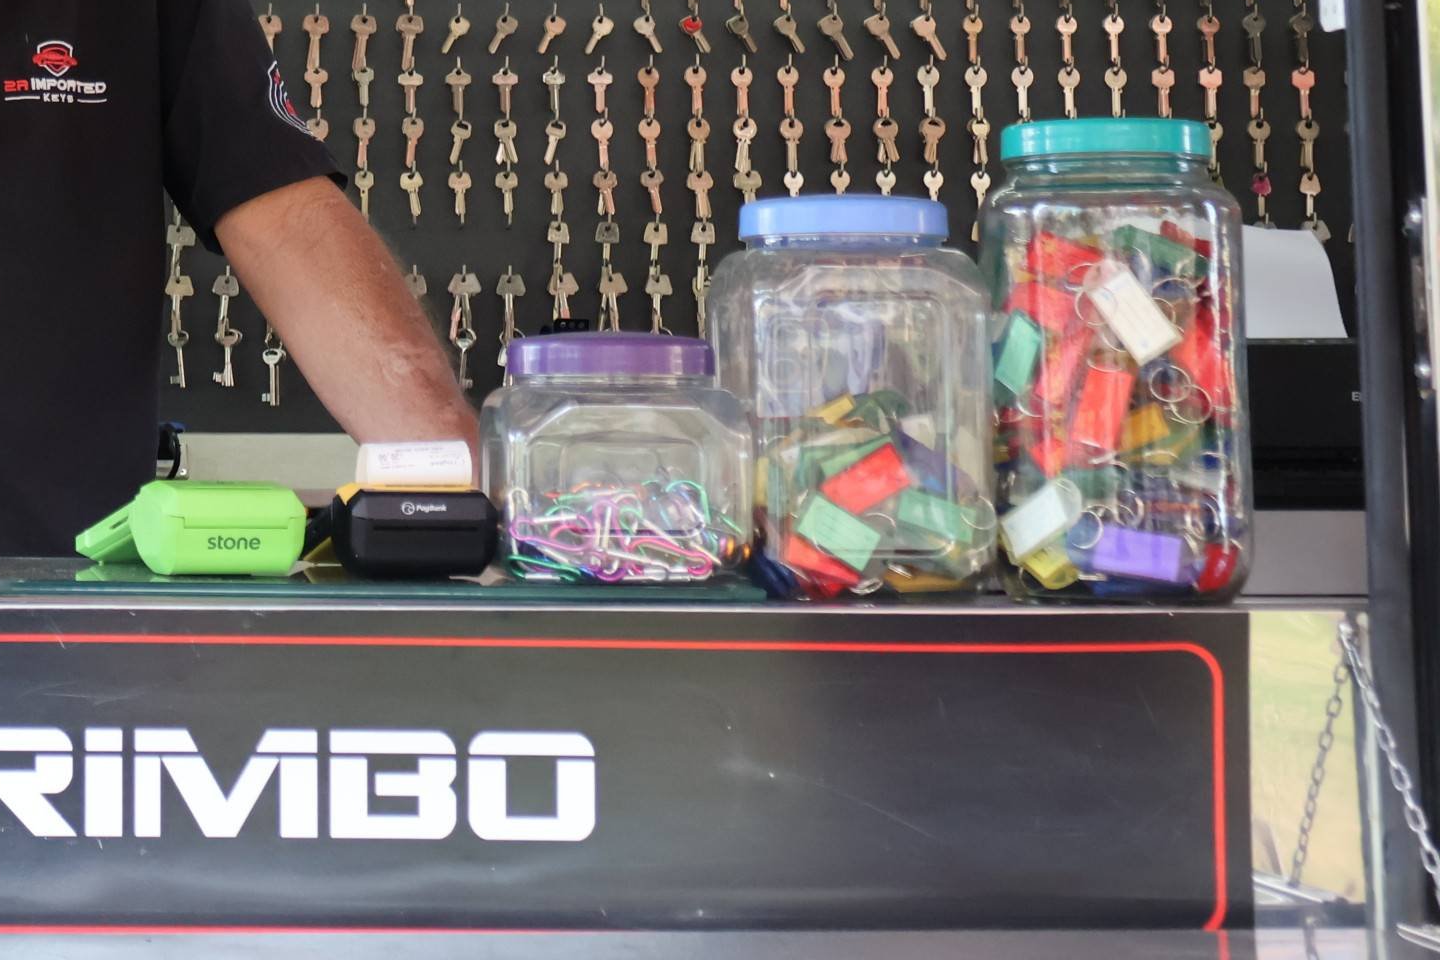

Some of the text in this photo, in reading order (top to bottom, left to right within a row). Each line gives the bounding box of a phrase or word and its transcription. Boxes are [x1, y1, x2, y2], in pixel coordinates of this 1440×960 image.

[30, 77, 106, 95] IMPORTED
[43, 93, 74, 103] KEYS
[208, 535, 261, 550] stone
